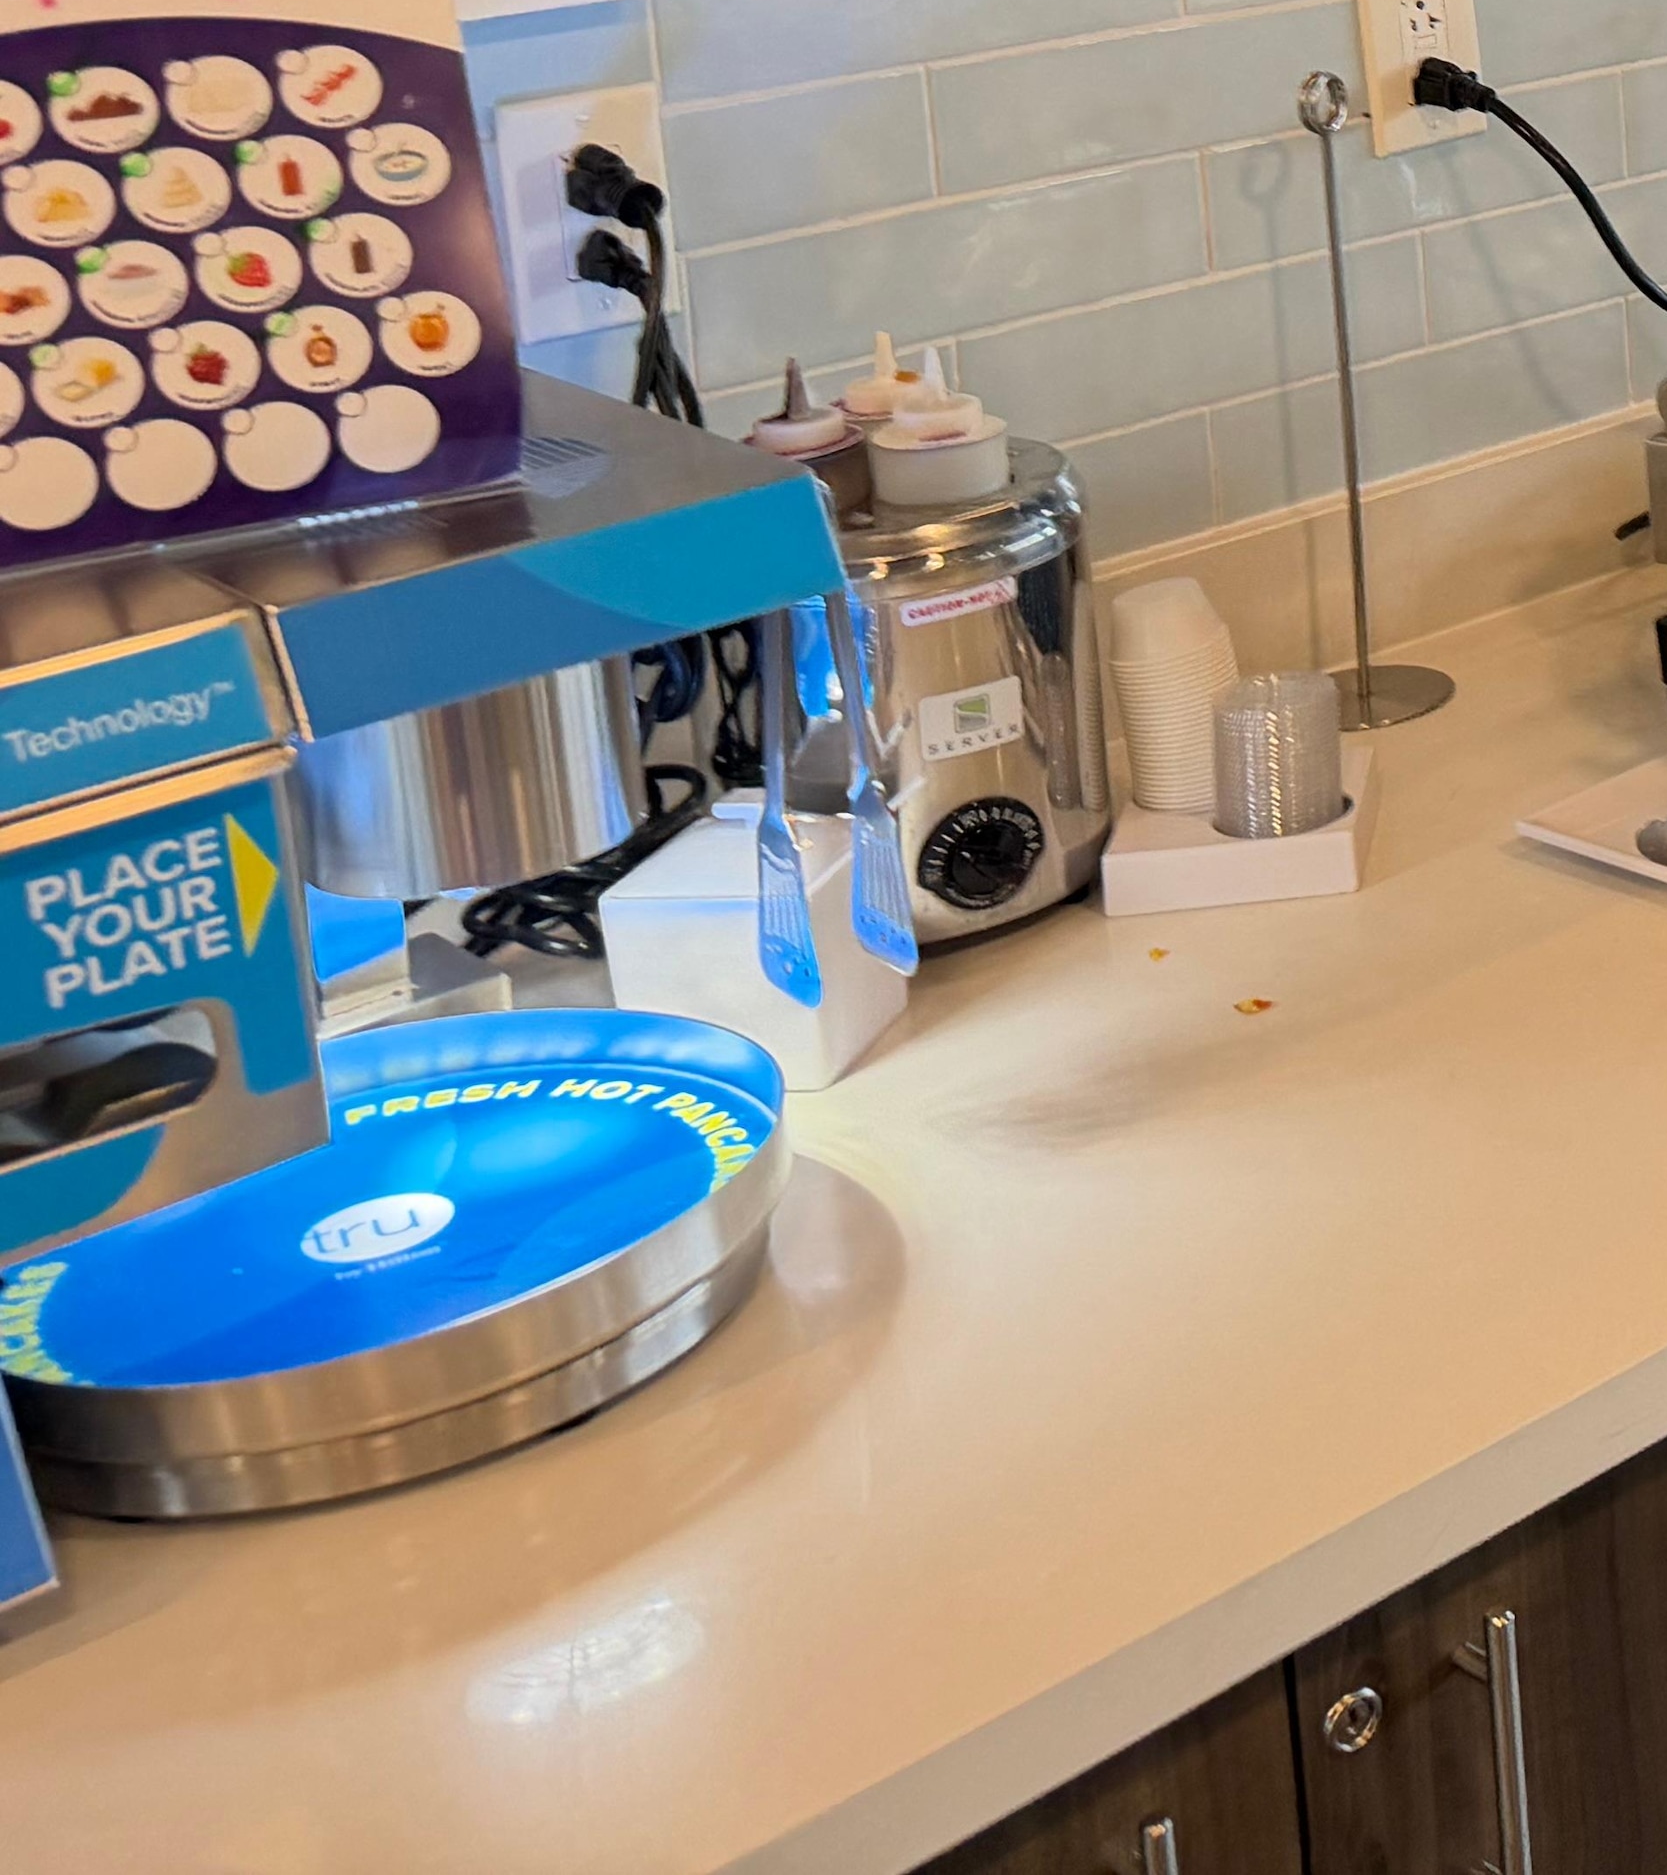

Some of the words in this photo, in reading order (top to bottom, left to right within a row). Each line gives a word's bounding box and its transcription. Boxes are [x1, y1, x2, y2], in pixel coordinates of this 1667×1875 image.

[927, 723, 1020, 756] SERVER
[25, 827, 222, 921] PLACE
[42, 876, 219, 958] YOUR
[44, 915, 232, 1009] PLATE
[344, 1078, 542, 1126] FRESH
[549, 1078, 666, 1104] HOT
[303, 1208, 420, 1254] tru
